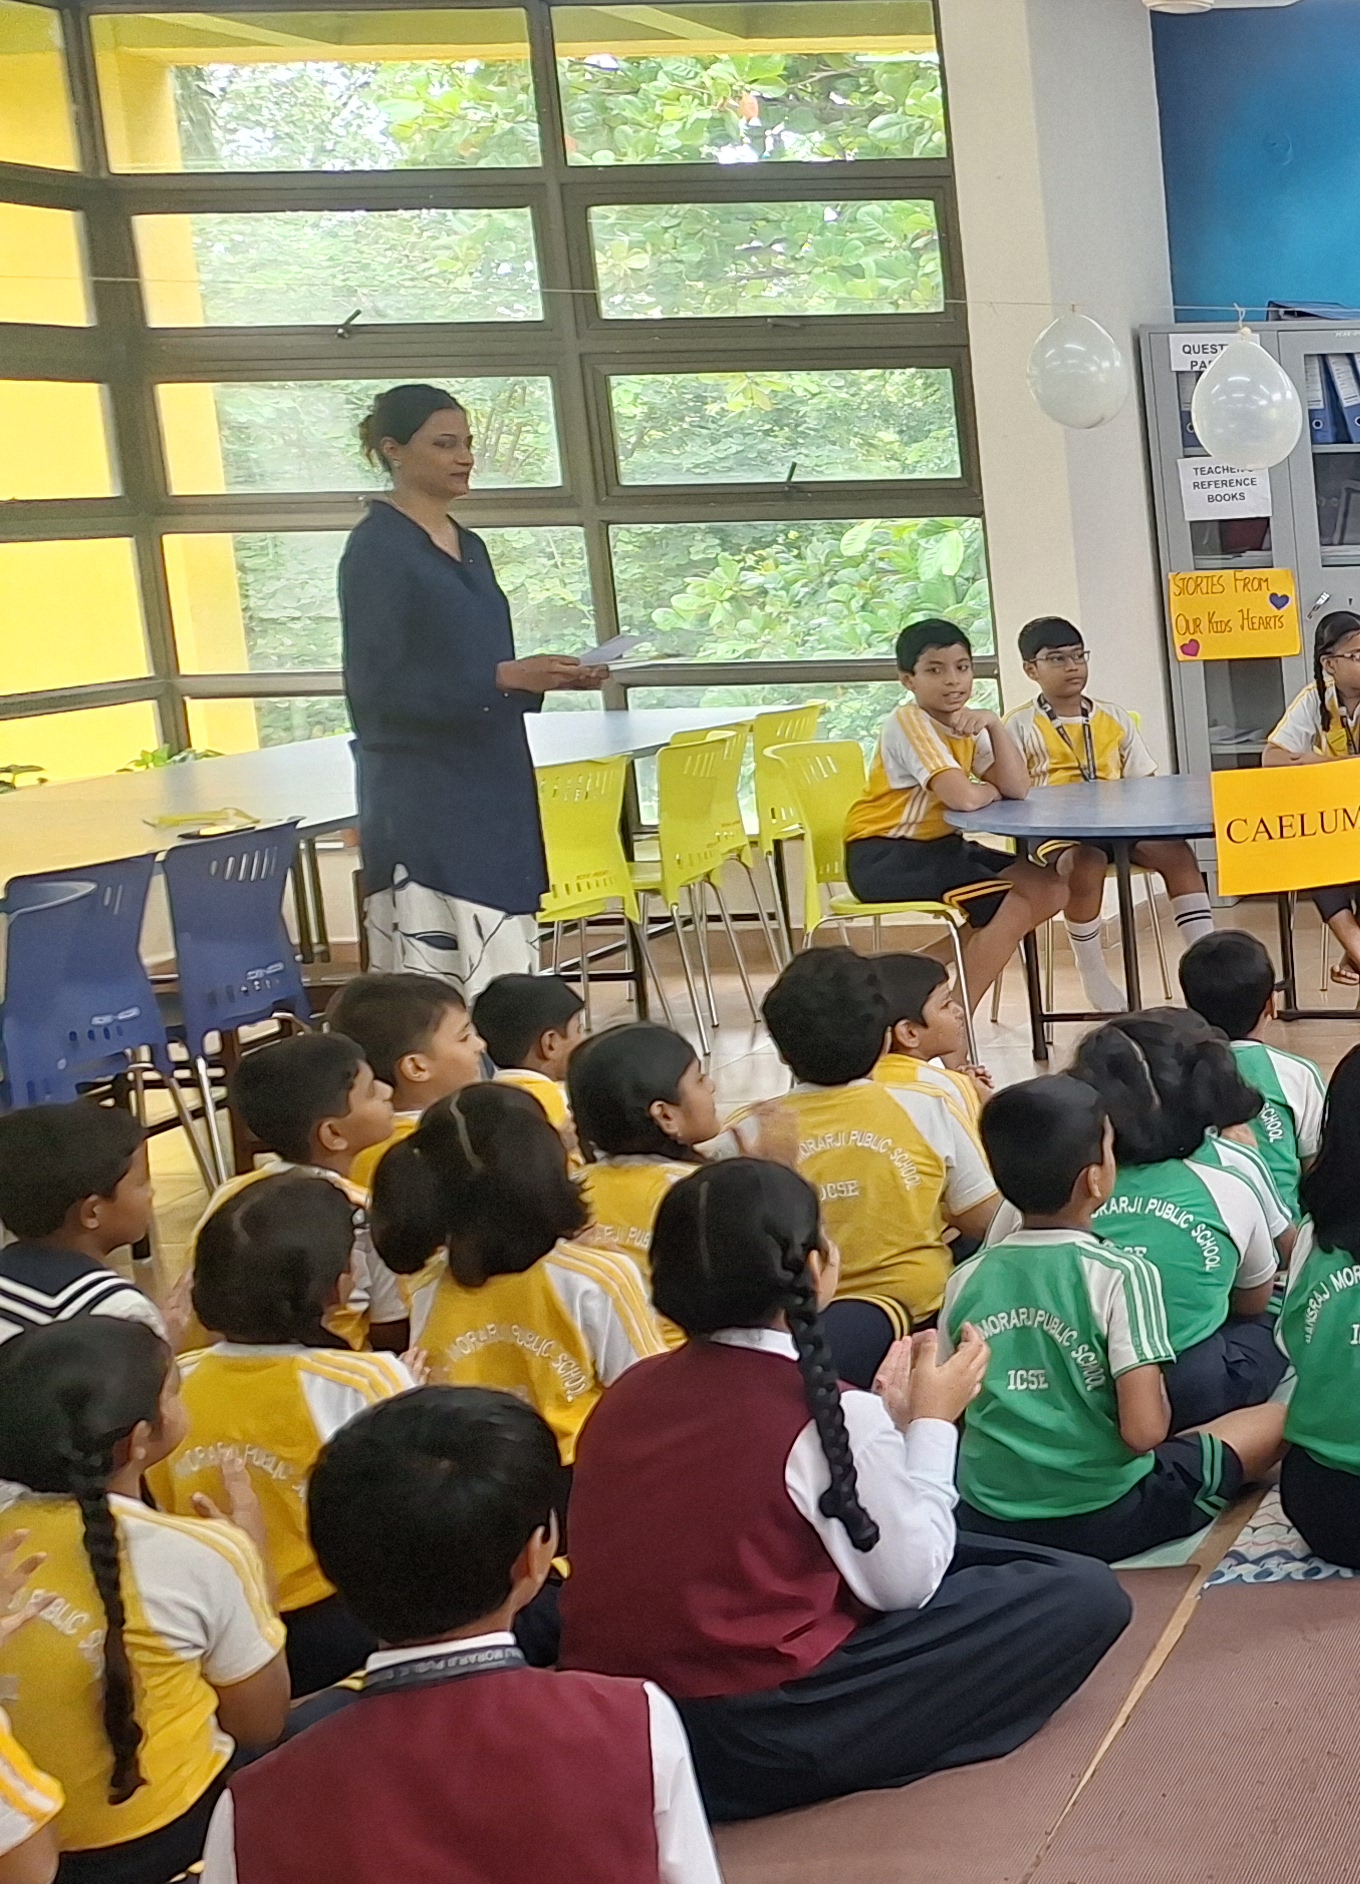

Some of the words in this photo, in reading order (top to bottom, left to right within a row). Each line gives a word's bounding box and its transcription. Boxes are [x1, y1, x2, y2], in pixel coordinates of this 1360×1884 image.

[1182, 343, 1229, 355] QUEST
[1192, 465, 1254, 476] TEACHE
[1192, 477, 1258, 491] REFERENCE
[1206, 491, 1246, 503] BOOKS
[1173, 572, 1226, 597] STORIES
[1175, 613, 1203, 636] OUR
[1237, 608, 1285, 632] HEARTS
[797, 1131, 846, 1164] ORARJI
[848, 1130, 893, 1154] PUBLIC
[889, 1147, 922, 1192] SCHOOL
[1091, 1196, 1143, 1219] RARJI
[1145, 1198, 1194, 1229] PUBLIC
[1191, 1223, 1222, 1272] SCHOOL
[1034, 1309, 1078, 1347] PUBLIC
[1007, 1369, 1049, 1391] ICSE
